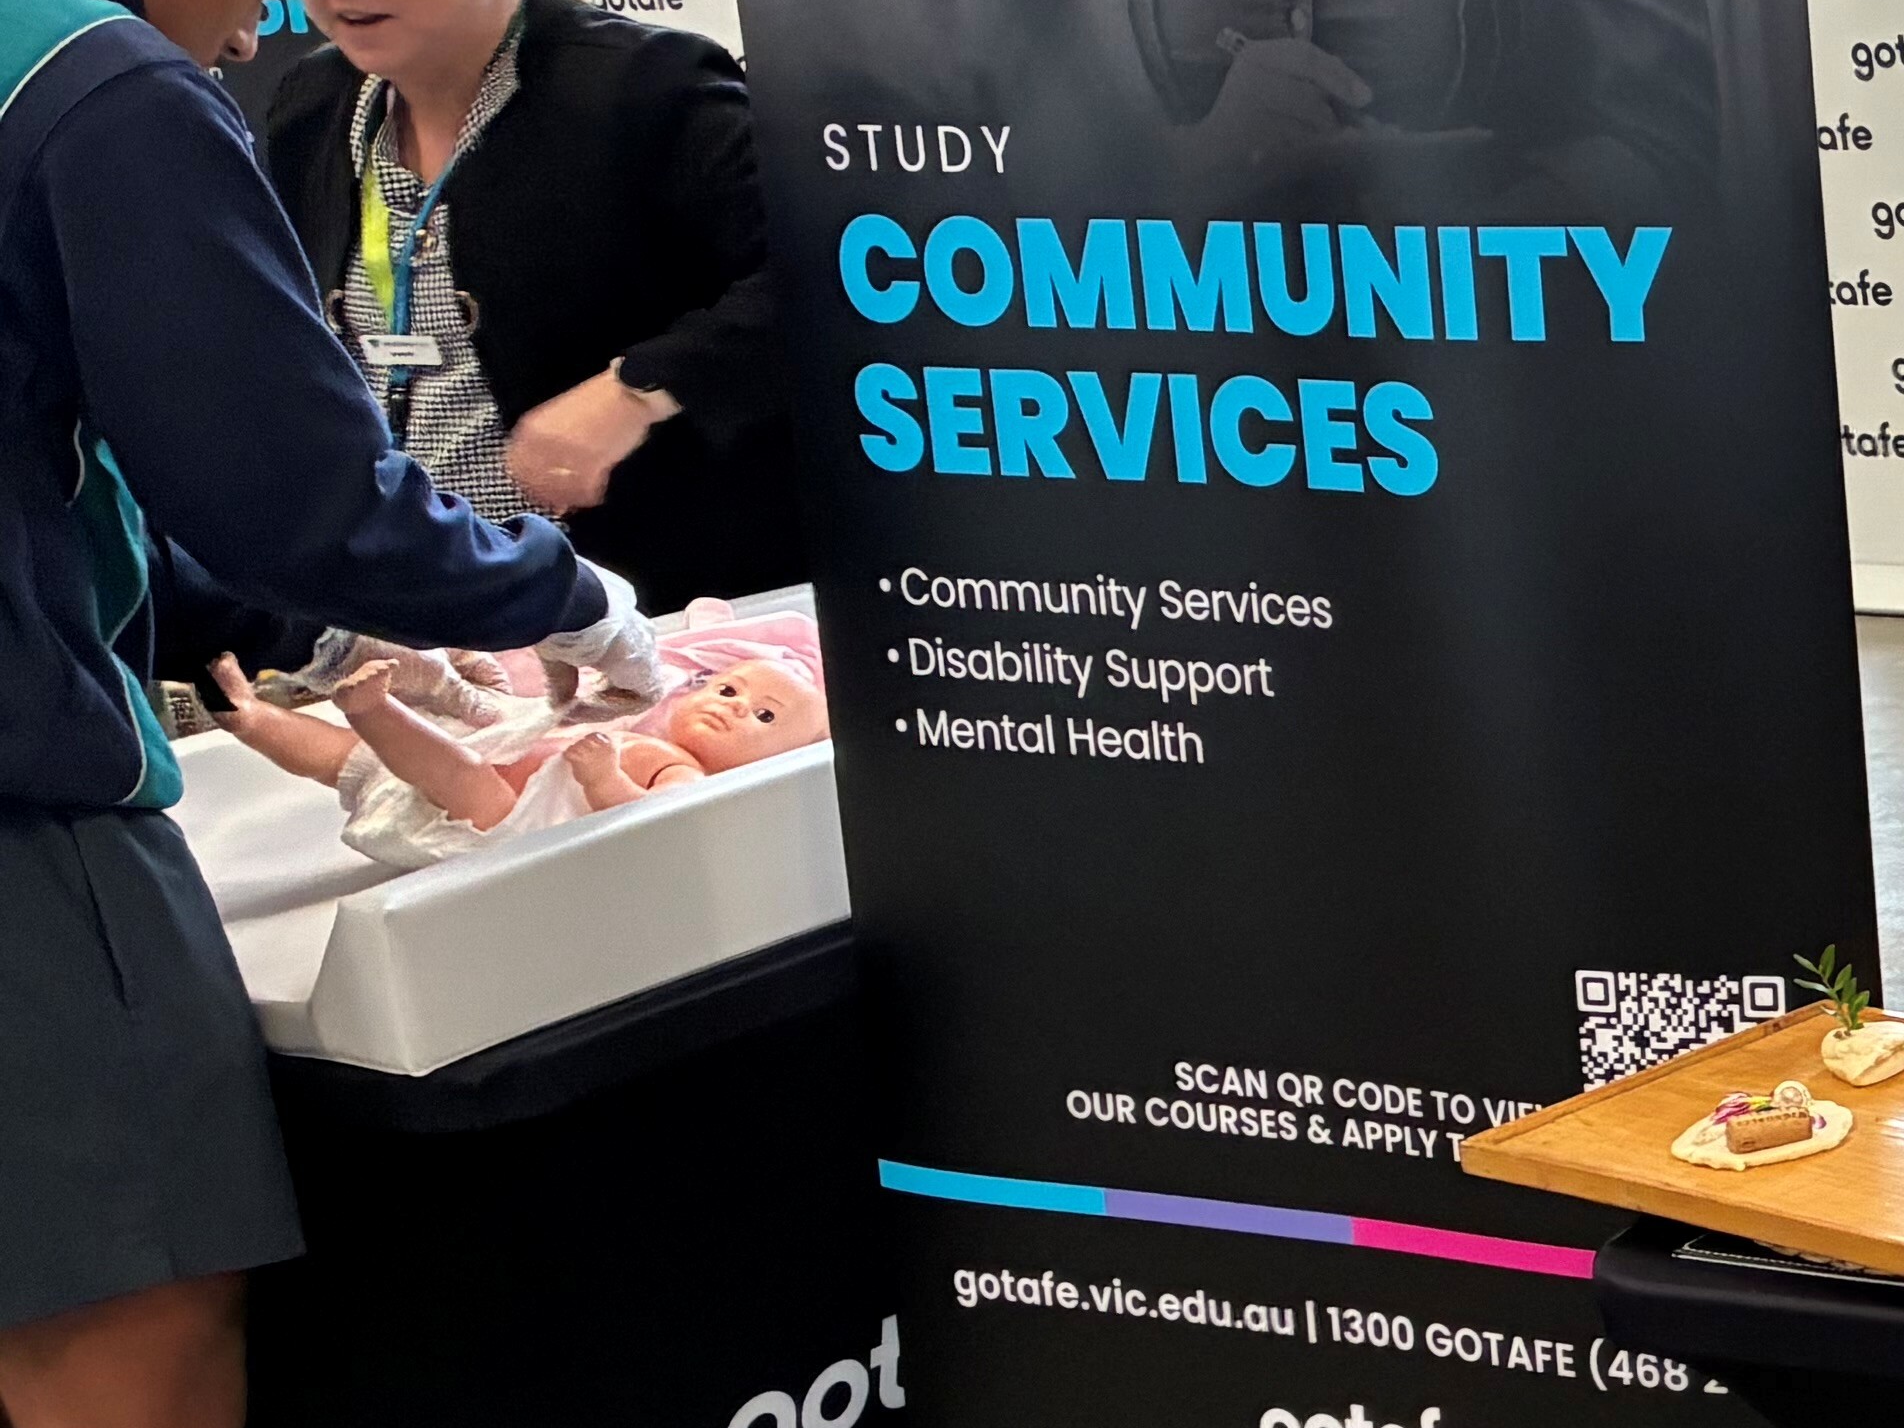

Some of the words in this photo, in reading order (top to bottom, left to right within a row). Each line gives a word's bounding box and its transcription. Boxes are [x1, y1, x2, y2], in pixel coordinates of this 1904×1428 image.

[824, 124, 1010, 173] STUDY
[840, 214, 1672, 342] COMMUNITY
[855, 363, 1438, 496] SERVICES
[901, 568, 1146, 630] Community
[1159, 580, 1332, 628] Services
[908, 637, 1093, 698] Disability
[1106, 649, 1274, 705] Support
[917, 709, 1055, 754] Mental
[1067, 718, 1204, 763] Health
[1067, 1090, 1136, 1123] OUR
[1145, 1097, 1297, 1140] COURSES
[1307, 1114, 1333, 1144] &
[1342, 1119, 1437, 1158] APPLY
[1175, 1062, 1267, 1099] SCAN
[1277, 1072, 1324, 1107] QR
[1333, 1079, 1423, 1117] CODE
[1430, 1091, 1475, 1124] TO
[954, 1270, 1294, 1335] gotafe.vic.edu.au
[1327, 1307, 1414, 1350] 1300
[1426, 1323, 1576, 1377] GOTAFE
